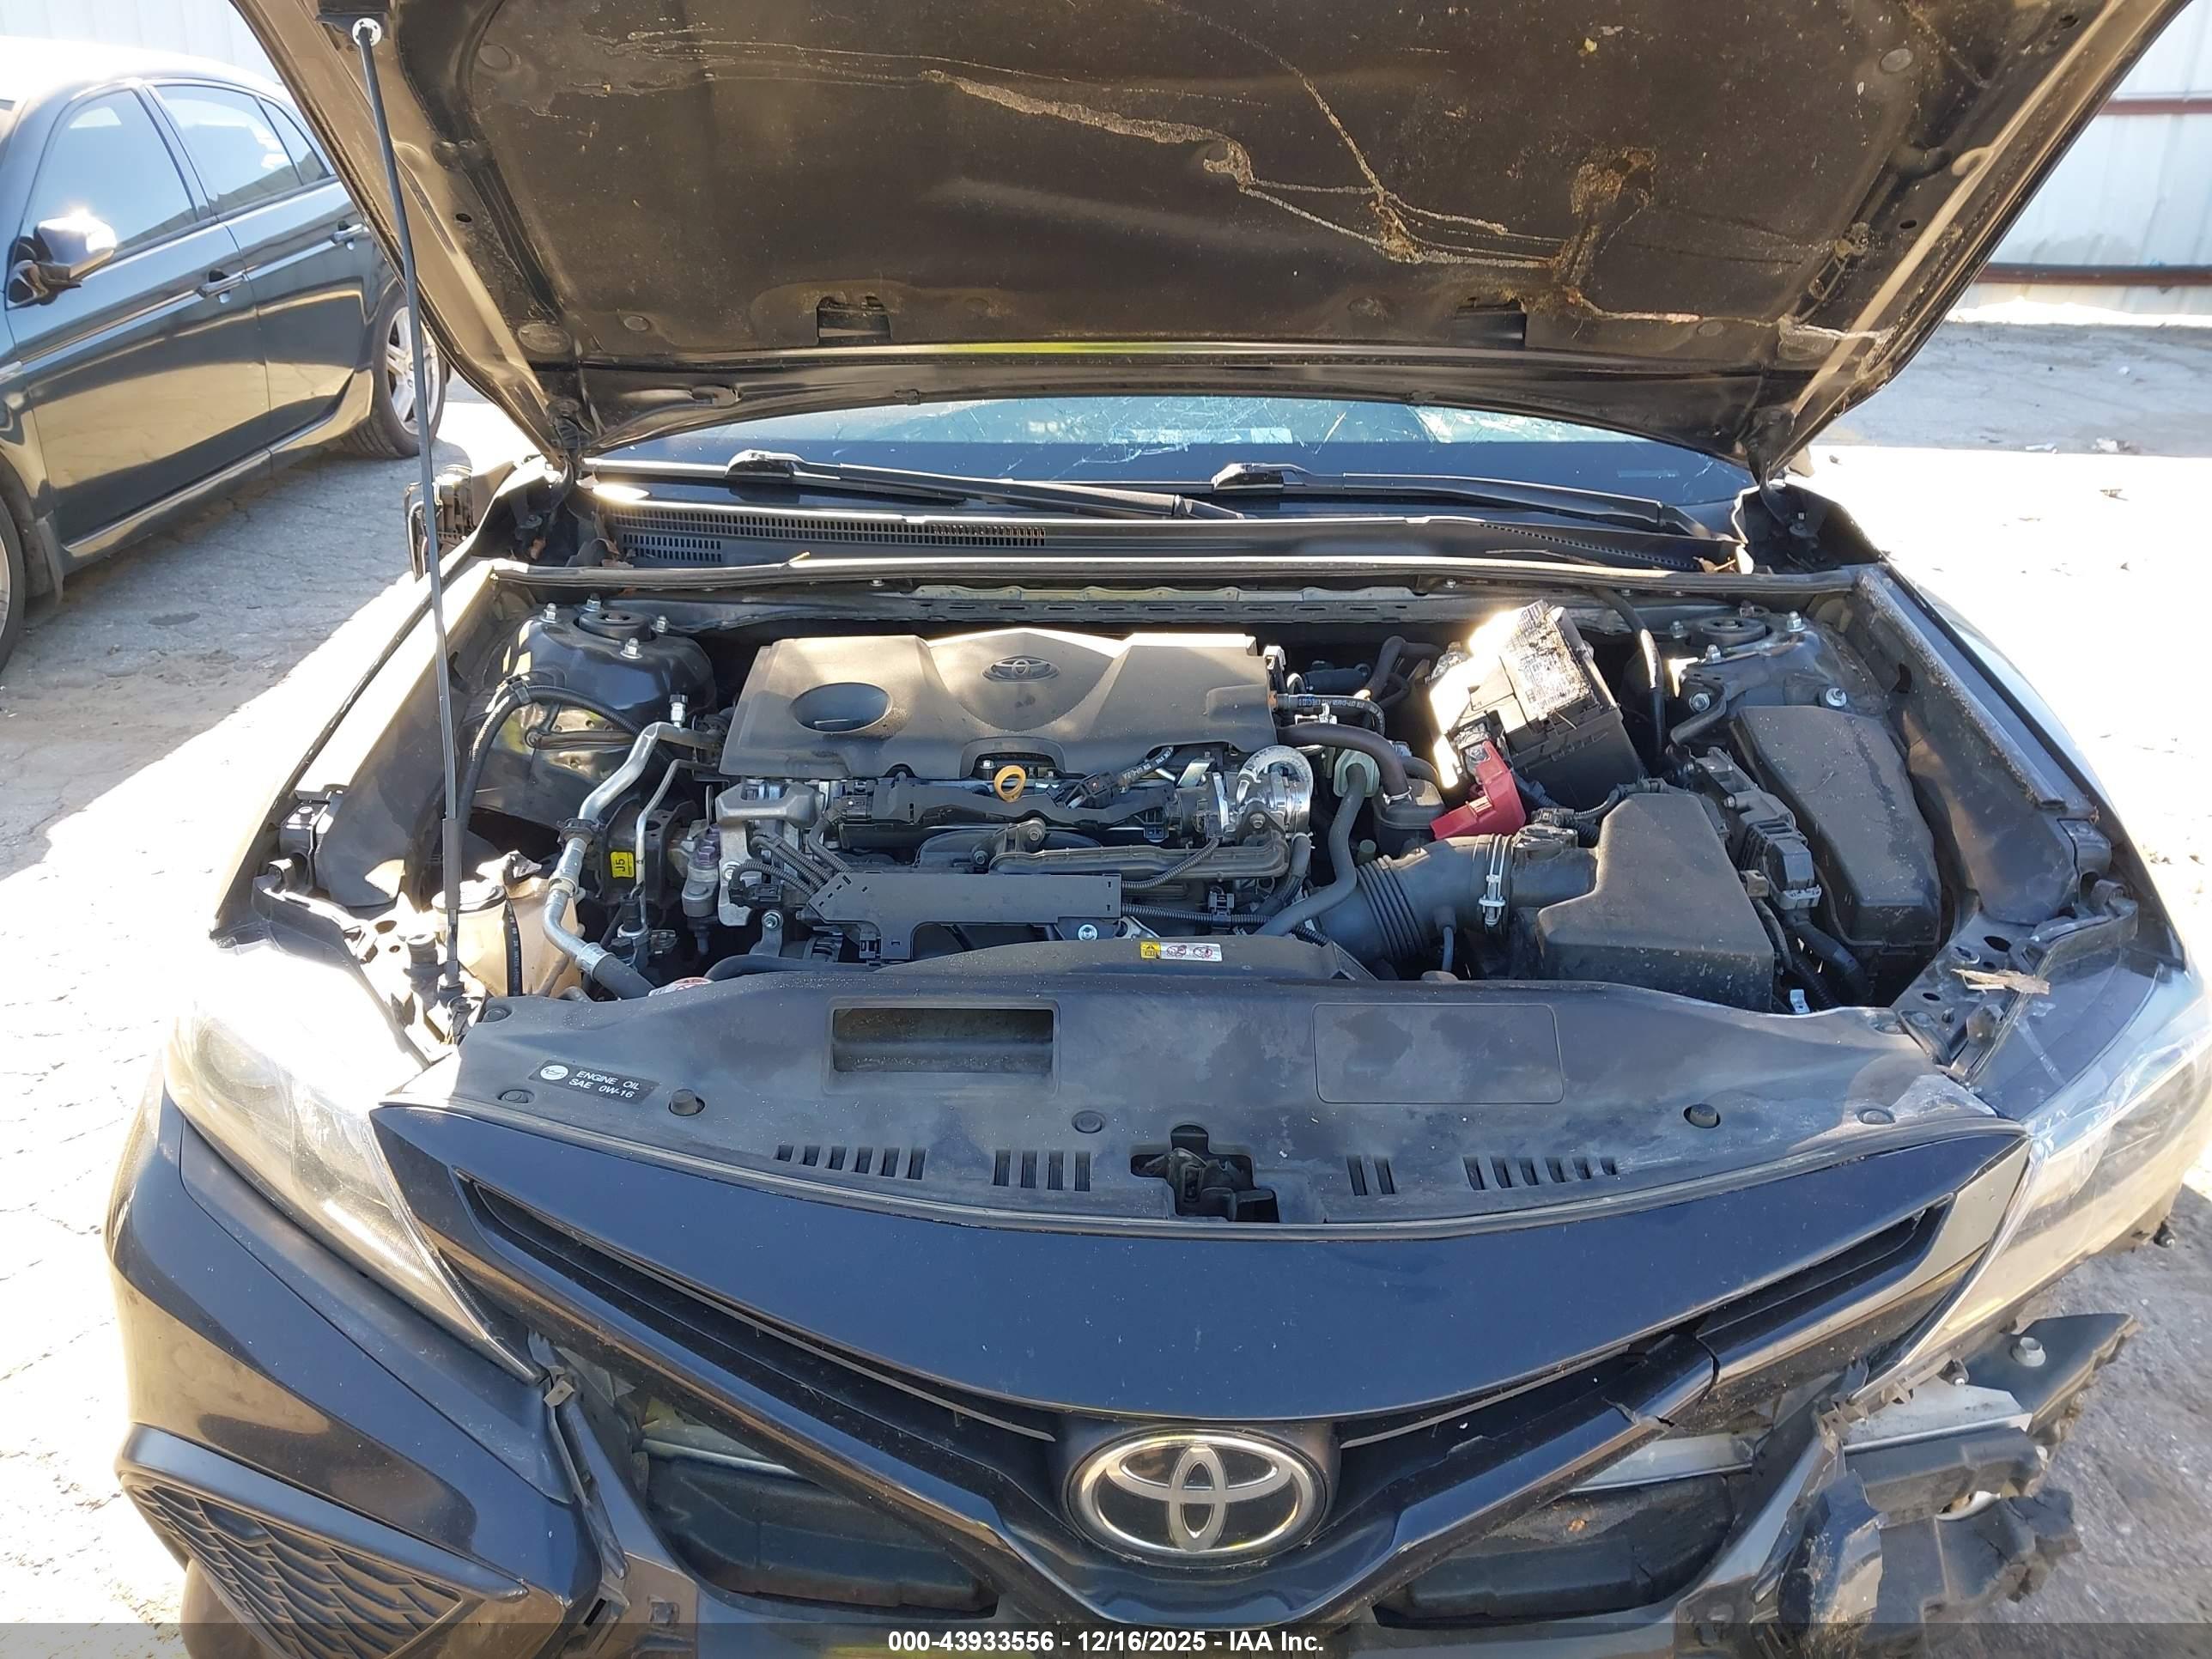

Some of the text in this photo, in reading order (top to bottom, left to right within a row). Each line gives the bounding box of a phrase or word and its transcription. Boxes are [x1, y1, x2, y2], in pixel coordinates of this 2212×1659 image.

[615, 859, 626, 872] J5
[568, 1078, 635, 1098] SAE 0W-16
[576, 1071, 640, 1091] ENGINE OIL
